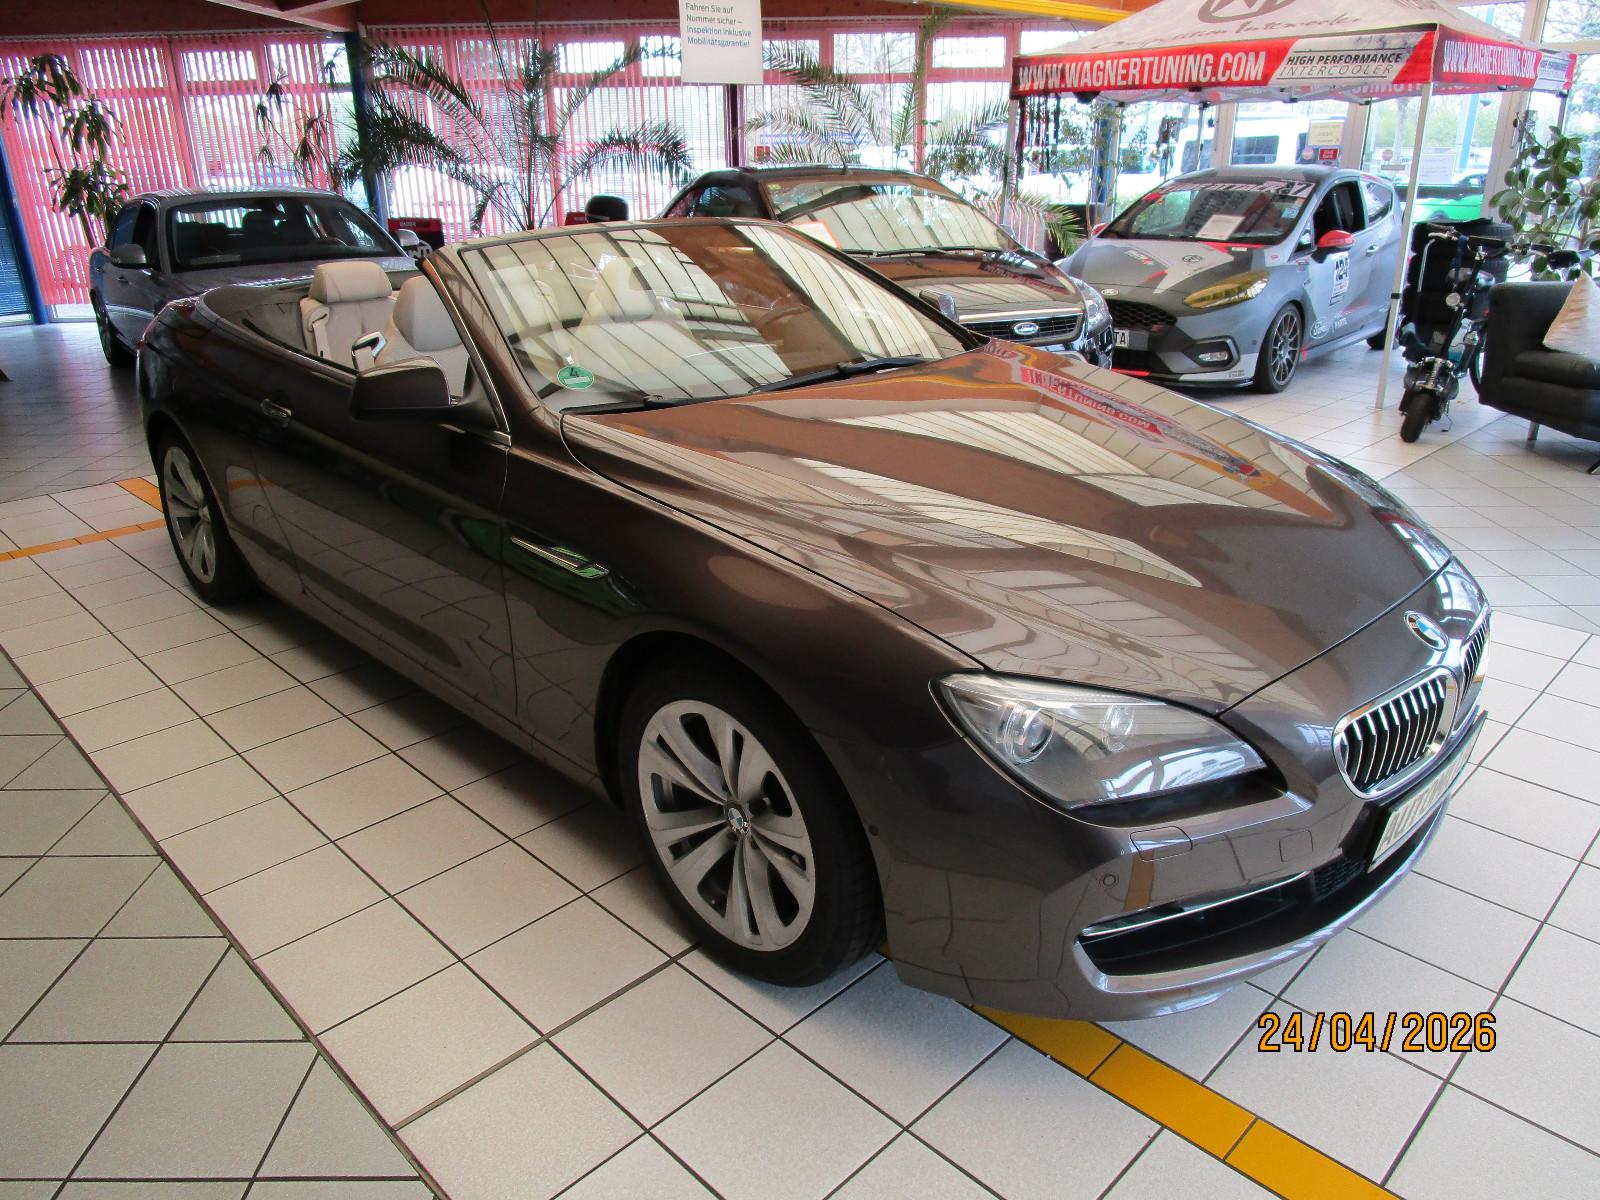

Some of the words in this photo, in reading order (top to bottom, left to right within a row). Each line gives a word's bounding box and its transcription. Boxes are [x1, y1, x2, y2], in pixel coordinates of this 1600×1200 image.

[685, 2, 709, 12] Fahren
[722, 6, 733, 14] auf
[686, 15, 716, 24] Nummer
[718, 16, 736, 25] sicher
[686, 26, 721, 35] Inspektion
[723, 28, 752, 37] inklusive
[1287, 55, 1315, 66] HIGH
[1318, 52, 1402, 65] PERFORMANCE
[1442, 40, 1537, 79] WWW.WAGNERTUNING.COM
[1018, 51, 1266, 91] WWW.WAGNERTUNING.COM
[1280, 64, 1393, 76] INTERCOOLER
